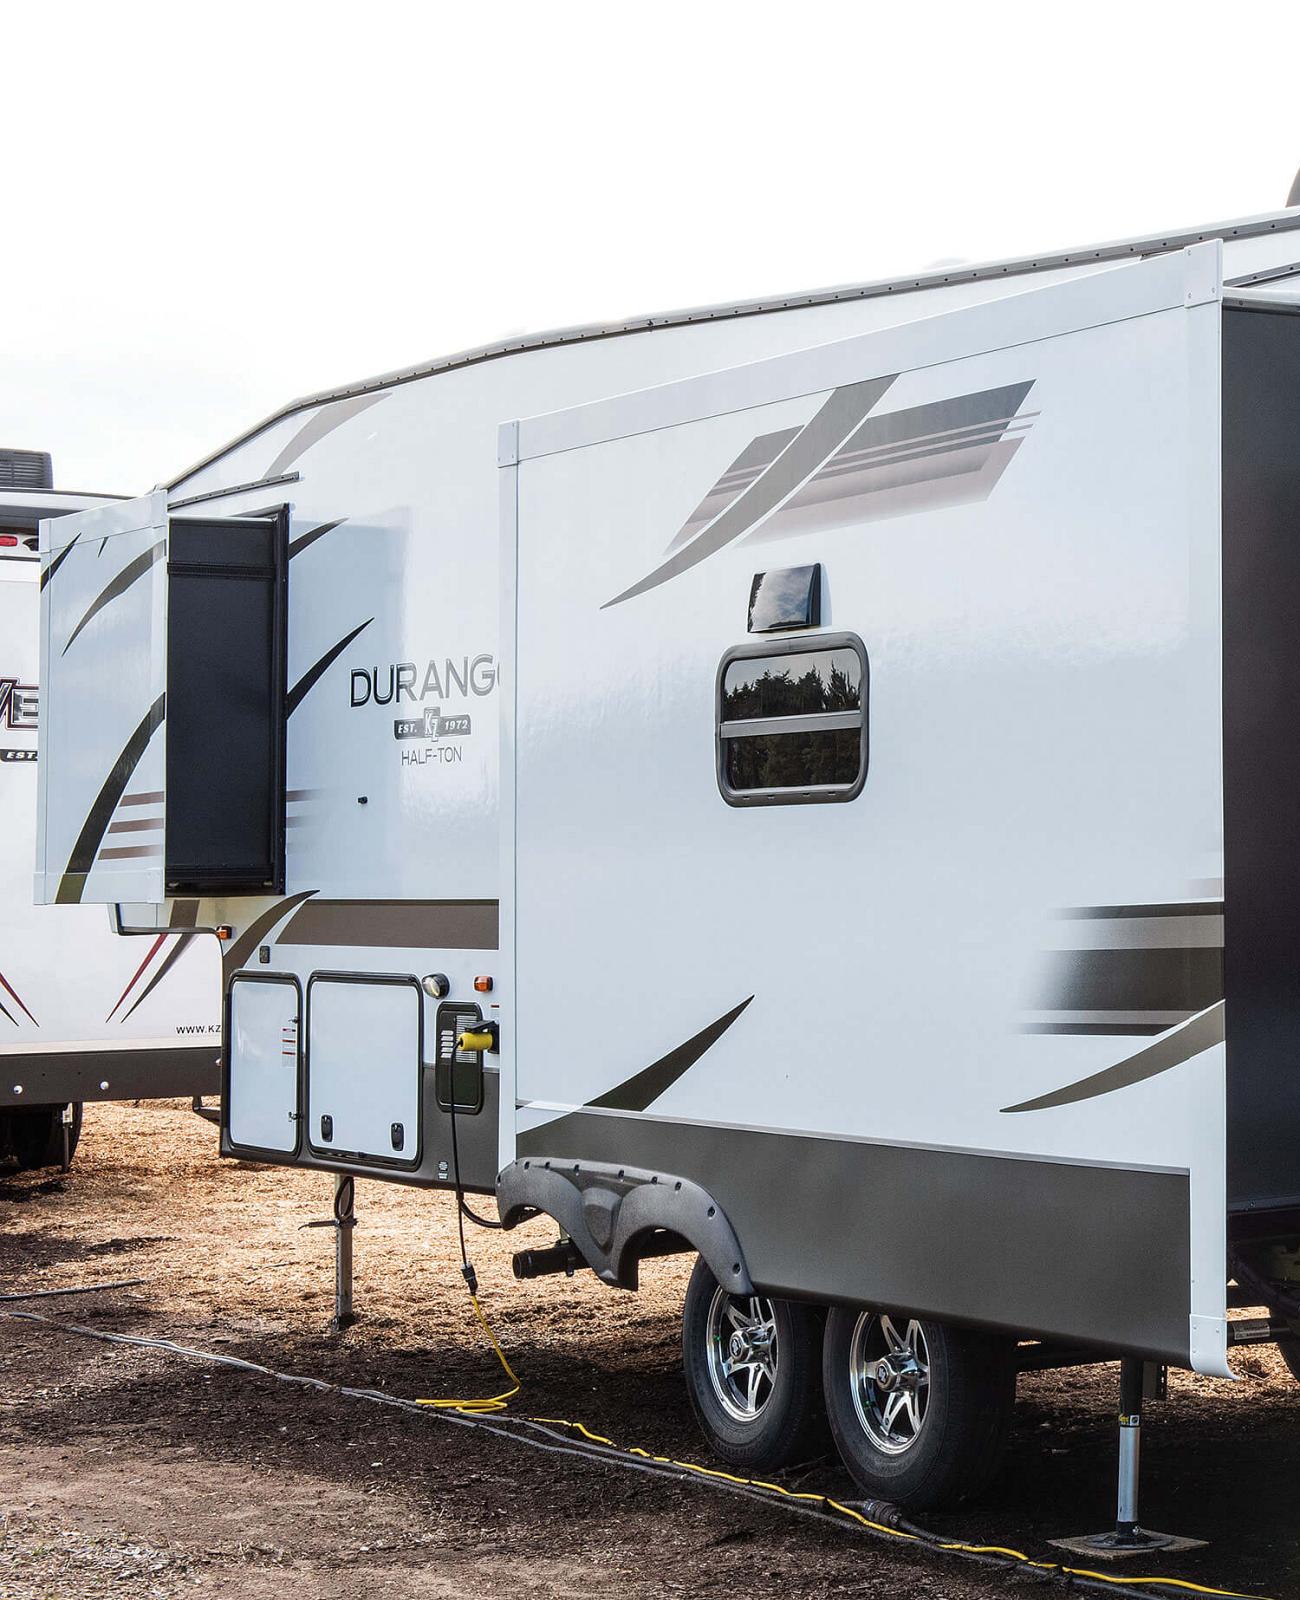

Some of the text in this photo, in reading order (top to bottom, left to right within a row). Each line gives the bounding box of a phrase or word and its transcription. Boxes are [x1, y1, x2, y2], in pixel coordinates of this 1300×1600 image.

[351, 653, 499, 708] DURANG
[398, 723, 417, 734] EST.
[444, 719, 469, 731] 1972
[401, 746, 463, 766] HALF-TON
